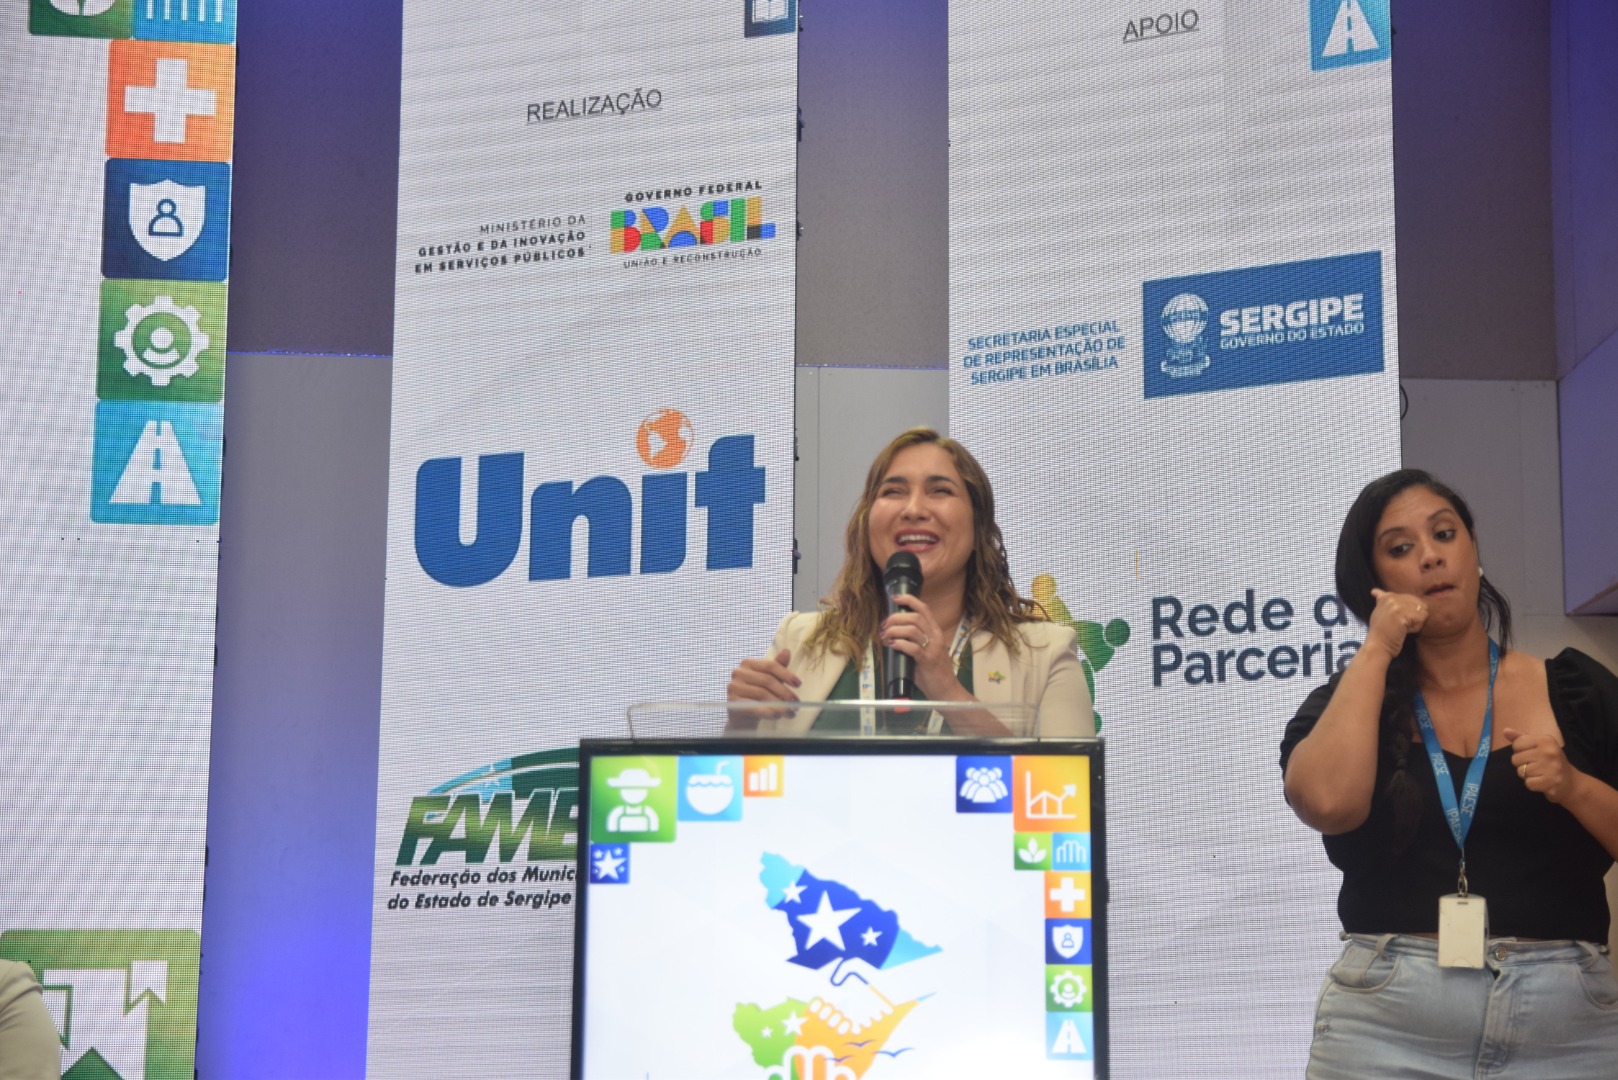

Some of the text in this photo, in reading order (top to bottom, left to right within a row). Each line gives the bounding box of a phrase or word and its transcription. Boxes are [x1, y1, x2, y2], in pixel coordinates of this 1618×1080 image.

[1123, 9, 1199, 40] APOIO
[527, 88, 662, 122] REALIZAÇÃO
[625, 181, 762, 203] GOVERNO FEDERAL
[480, 214, 586, 234] MINISTÉRIO DA
[610, 196, 776, 254] BRASIL
[418, 231, 585, 257] GESTÃO E DA INOVAÇÃO
[623, 257, 657, 269] UNIÃO
[674, 248, 762, 263] RECONSTRUÇÃO
[415, 246, 585, 274] EM SERVIÇOS PÚBLICOS
[1220, 293, 1364, 337] SERGIPE
[968, 320, 1120, 350] SECRETARIA ESPECIAL
[1220, 322, 1364, 350] GOVERNO DO ESTADO
[963, 336, 1125, 368] DE REPRESENTAÇÃO DE
[971, 355, 1118, 385] SERGIPE EM BRASÍLIA
[414, 407, 766, 588] Unit
[1152, 588, 1348, 640] Rede d
[1431, 752, 1449, 776] IPAESE
[1461, 783, 1479, 817] IPAESE
[391, 865, 577, 888] Federação dos Munic
[388, 889, 571, 909] do Estado de Sergipe
